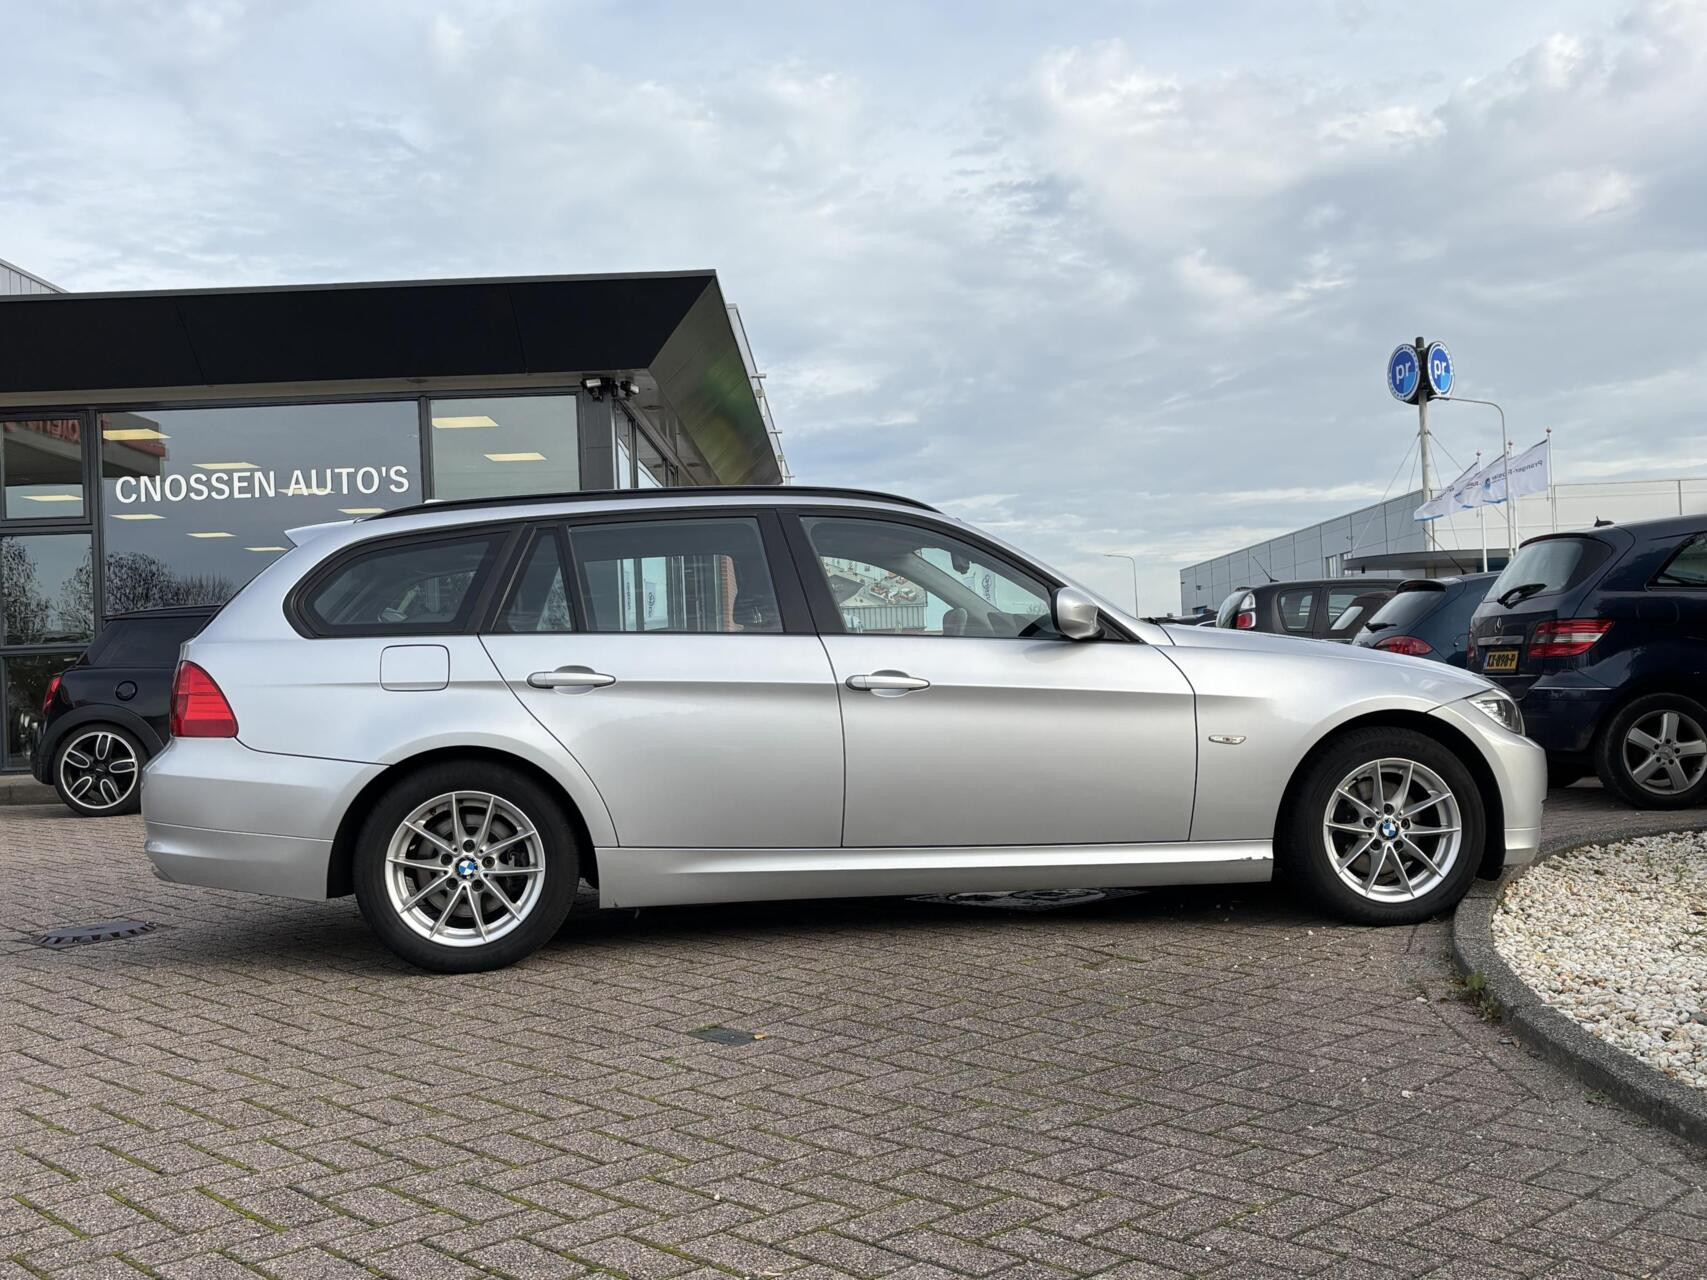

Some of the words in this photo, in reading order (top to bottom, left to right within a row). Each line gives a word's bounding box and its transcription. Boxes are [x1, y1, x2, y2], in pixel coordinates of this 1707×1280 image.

[1395, 361, 1411, 385] pr
[1433, 359, 1447, 380] pr
[115, 470, 275, 504] CNOSSEN
[287, 465, 409, 497] AUTO'S
